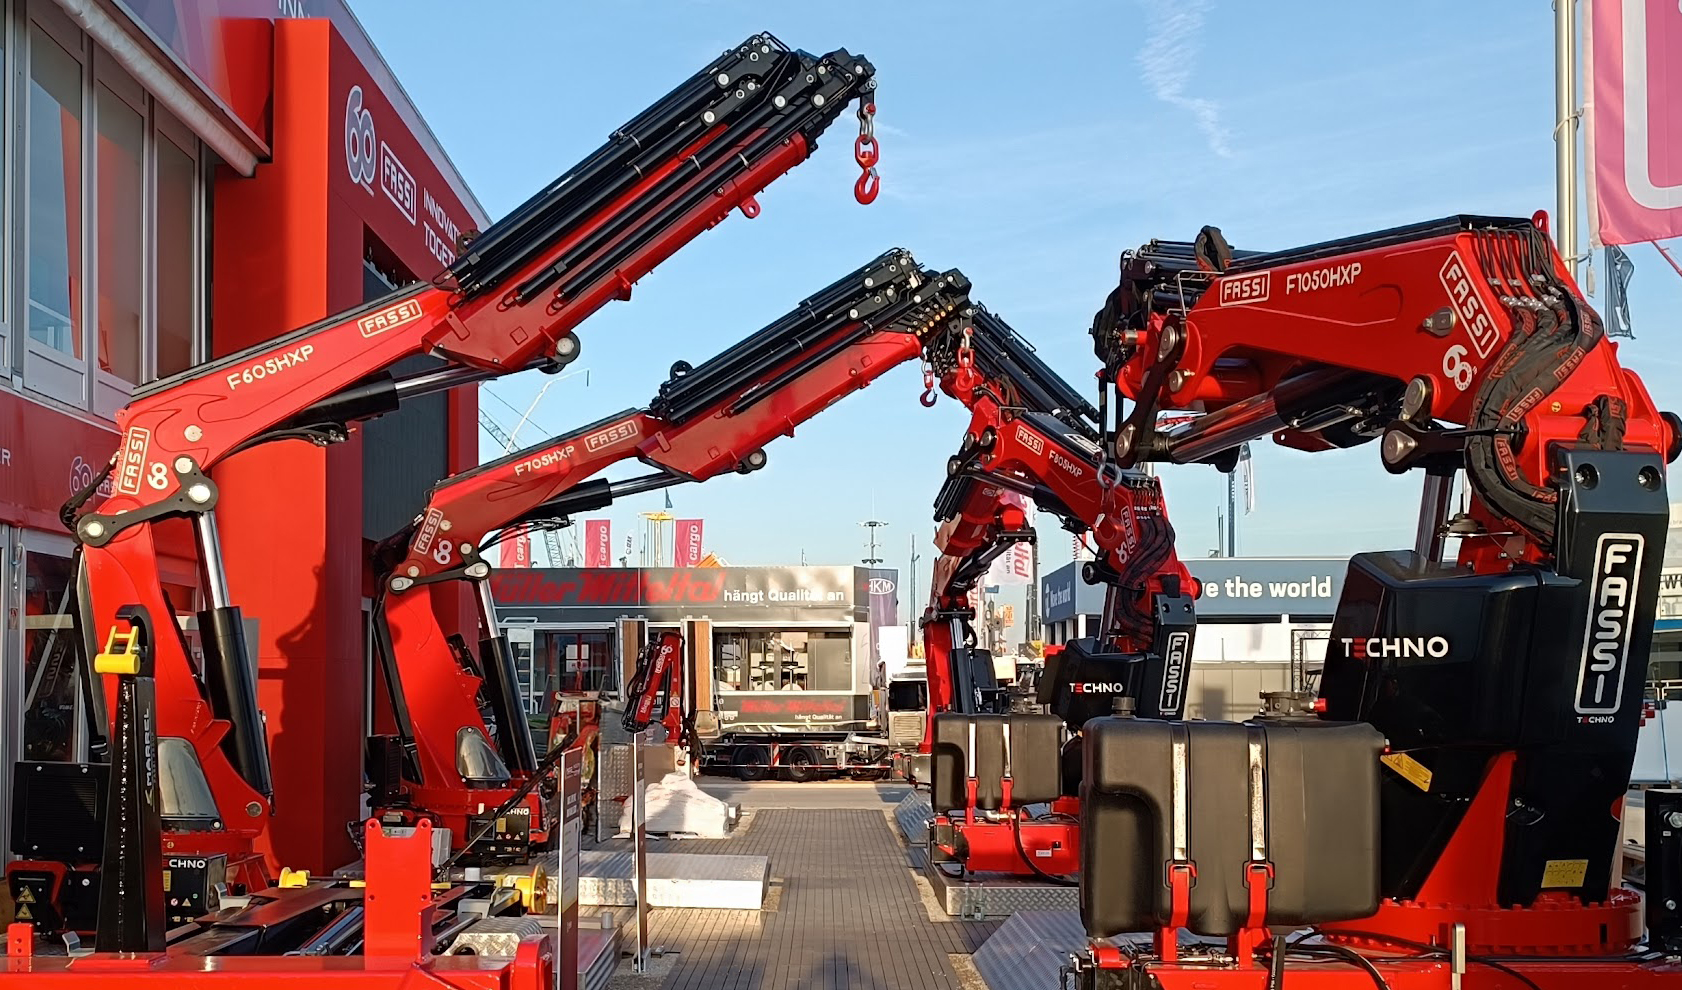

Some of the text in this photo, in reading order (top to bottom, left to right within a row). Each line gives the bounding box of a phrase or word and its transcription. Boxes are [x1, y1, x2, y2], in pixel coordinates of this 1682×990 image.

[344, 85, 376, 184] 60
[383, 156, 415, 214] FASSI
[423, 187, 462, 245] INNOVAT
[423, 220, 456, 268] TOGET
[1224, 276, 1266, 300] FASSI
[1286, 262, 1361, 296] F1050HXP
[364, 303, 417, 333] FASSI
[1445, 262, 1493, 347] FASSI
[226, 343, 314, 391] F605HXP
[1443, 344, 1473, 392] 60
[1555, 349, 1584, 378] FASSI
[1509, 389, 1541, 419] FASSI
[590, 424, 634, 449] FASSI
[1017, 428, 1043, 453] FASSI
[123, 432, 146, 488] FASSI
[514, 445, 575, 476] F705HXP
[1048, 450, 1083, 478] F805HXP
[1497, 439, 1518, 479] FASSI
[417, 511, 440, 550] FASSI
[599, 525, 608, 562] cargo
[689, 525, 699, 561] cargo
[723, 589, 845, 603] hängt Qualität an
[1225, 575, 1262, 598] the
[1269, 575, 1332, 598] world
[1588, 541, 1634, 706] FASSI
[1340, 635, 1449, 659] TECHNO
[1068, 682, 1123, 694] TECHNO
[1165, 636, 1185, 708] FASSI
[143, 708, 152, 787] MARREL
